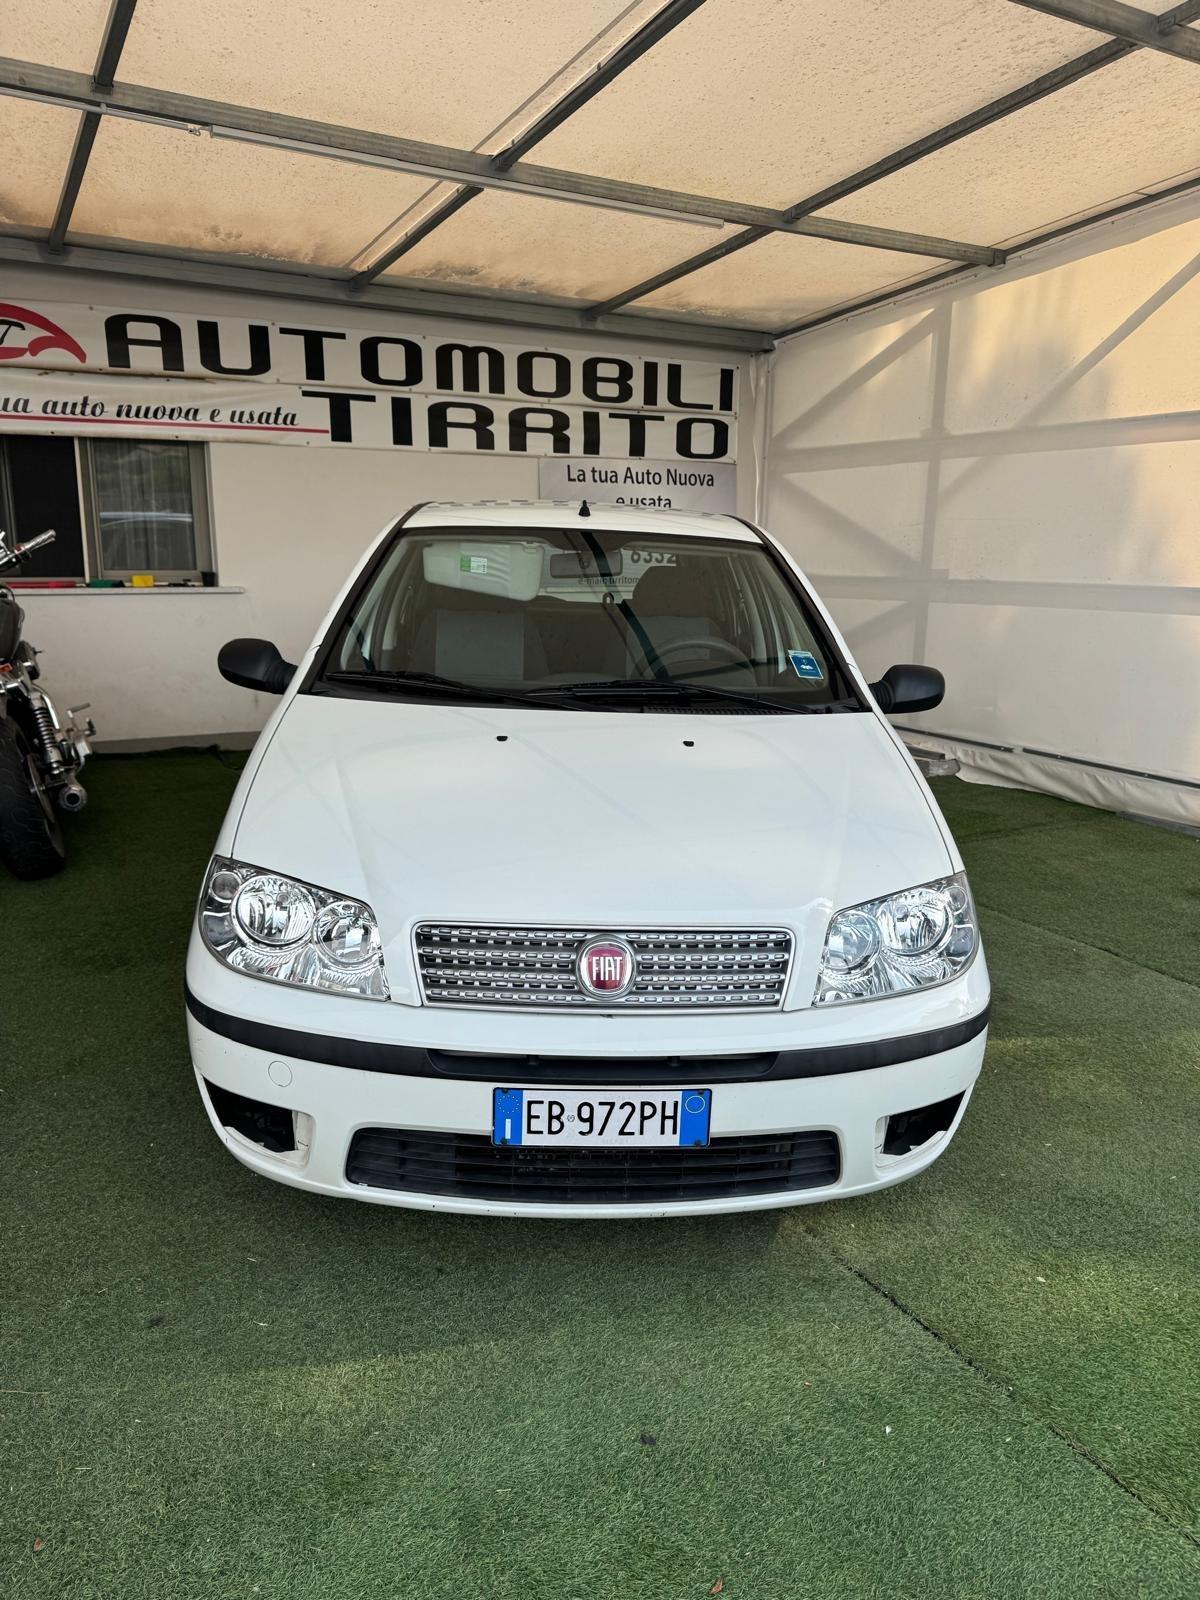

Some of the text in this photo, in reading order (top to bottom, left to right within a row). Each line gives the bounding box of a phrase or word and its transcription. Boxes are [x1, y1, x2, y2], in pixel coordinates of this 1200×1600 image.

[104, 313, 734, 412] AUTOMOBILI
[41, 396, 107, 417] auto
[116, 403, 201, 422] nuova
[209, 408, 223, 422] e
[230, 406, 299, 426] usata
[301, 390, 729, 459] TIRRITO
[567, 464, 714, 487] La tua Auto Nuova
[592, 956, 622, 981] FIAT
[526, 1100, 679, 1136] EB 972PH
